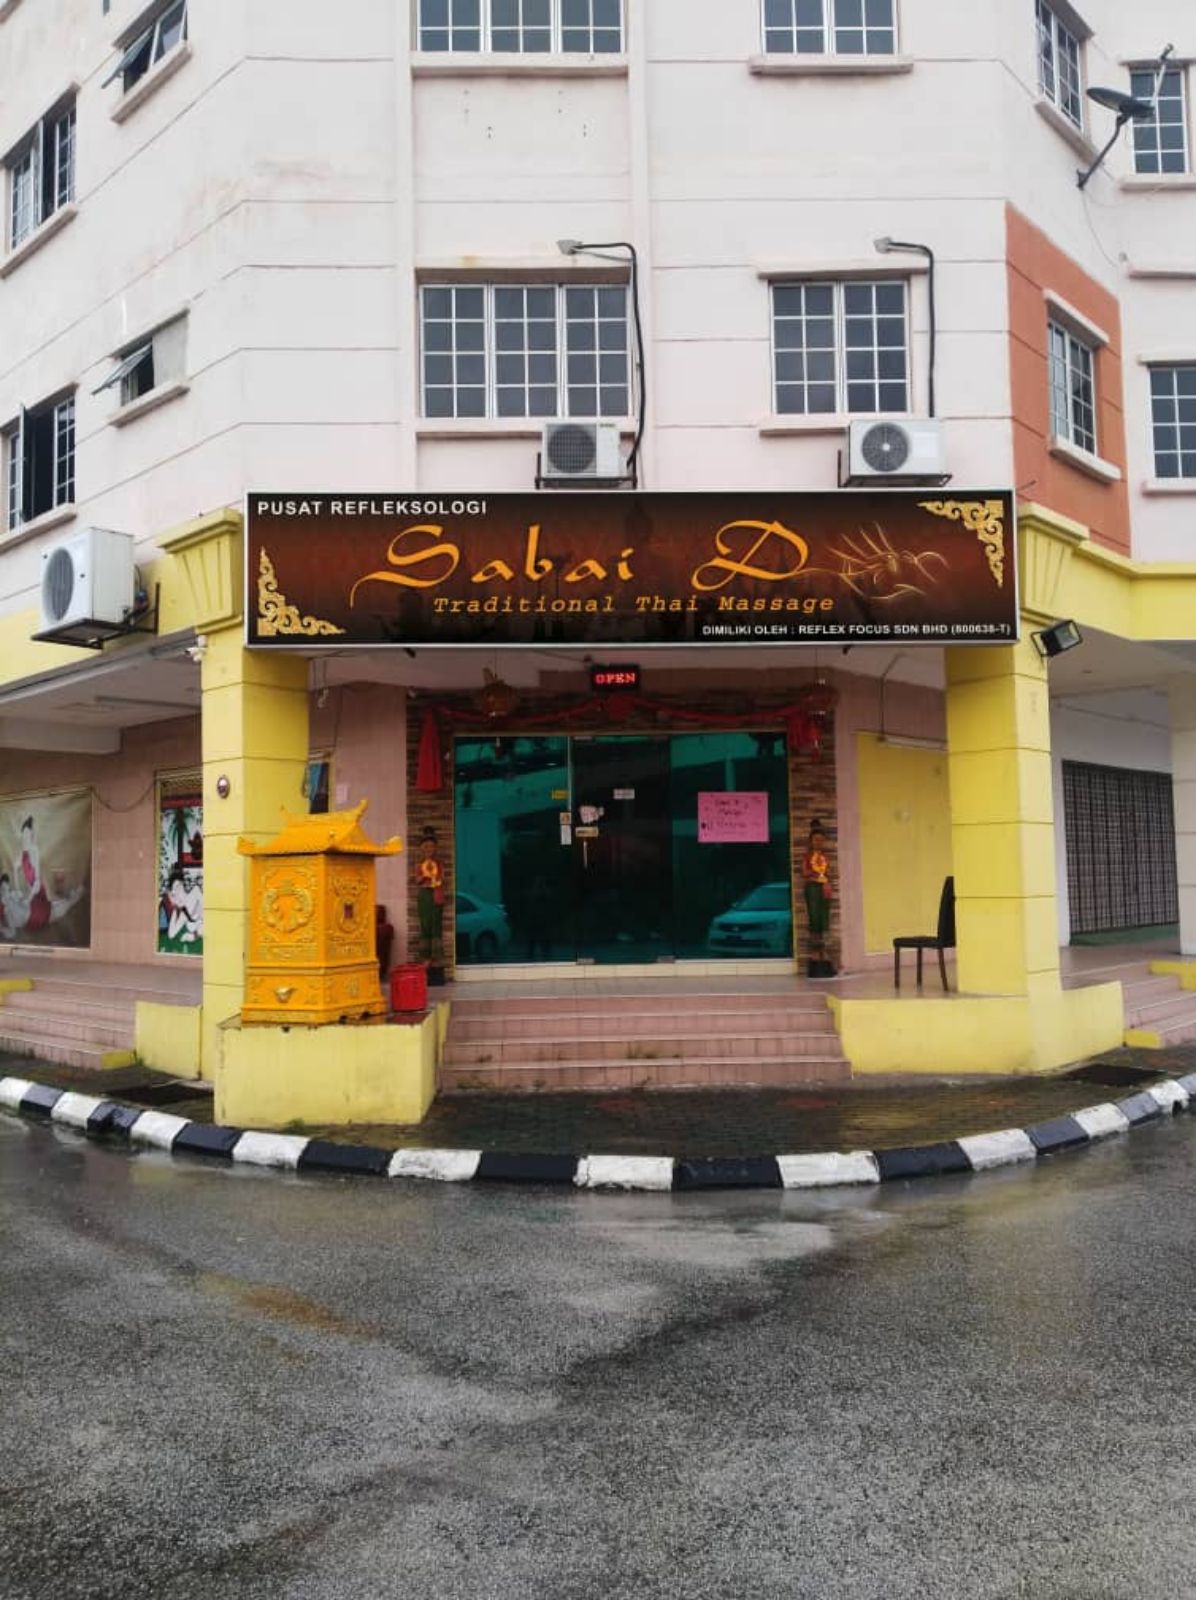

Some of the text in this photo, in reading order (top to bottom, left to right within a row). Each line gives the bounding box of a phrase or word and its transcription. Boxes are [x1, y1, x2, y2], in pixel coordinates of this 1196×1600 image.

[257, 500, 487, 515] PUSAT REFLEKSOLOGI
[350, 519, 809, 609] Sabai D
[434, 595, 834, 614] Traditional Thai Massage
[702, 625, 751, 635] DIMILIKI
[754, 625, 788, 635] OLEH
[798, 624, 846, 634] REFLEX
[849, 624, 890, 634] FOCUS
[893, 624, 919, 634] SDN
[922, 624, 948, 634] BHD
[595, 672, 636, 684] OPEN
